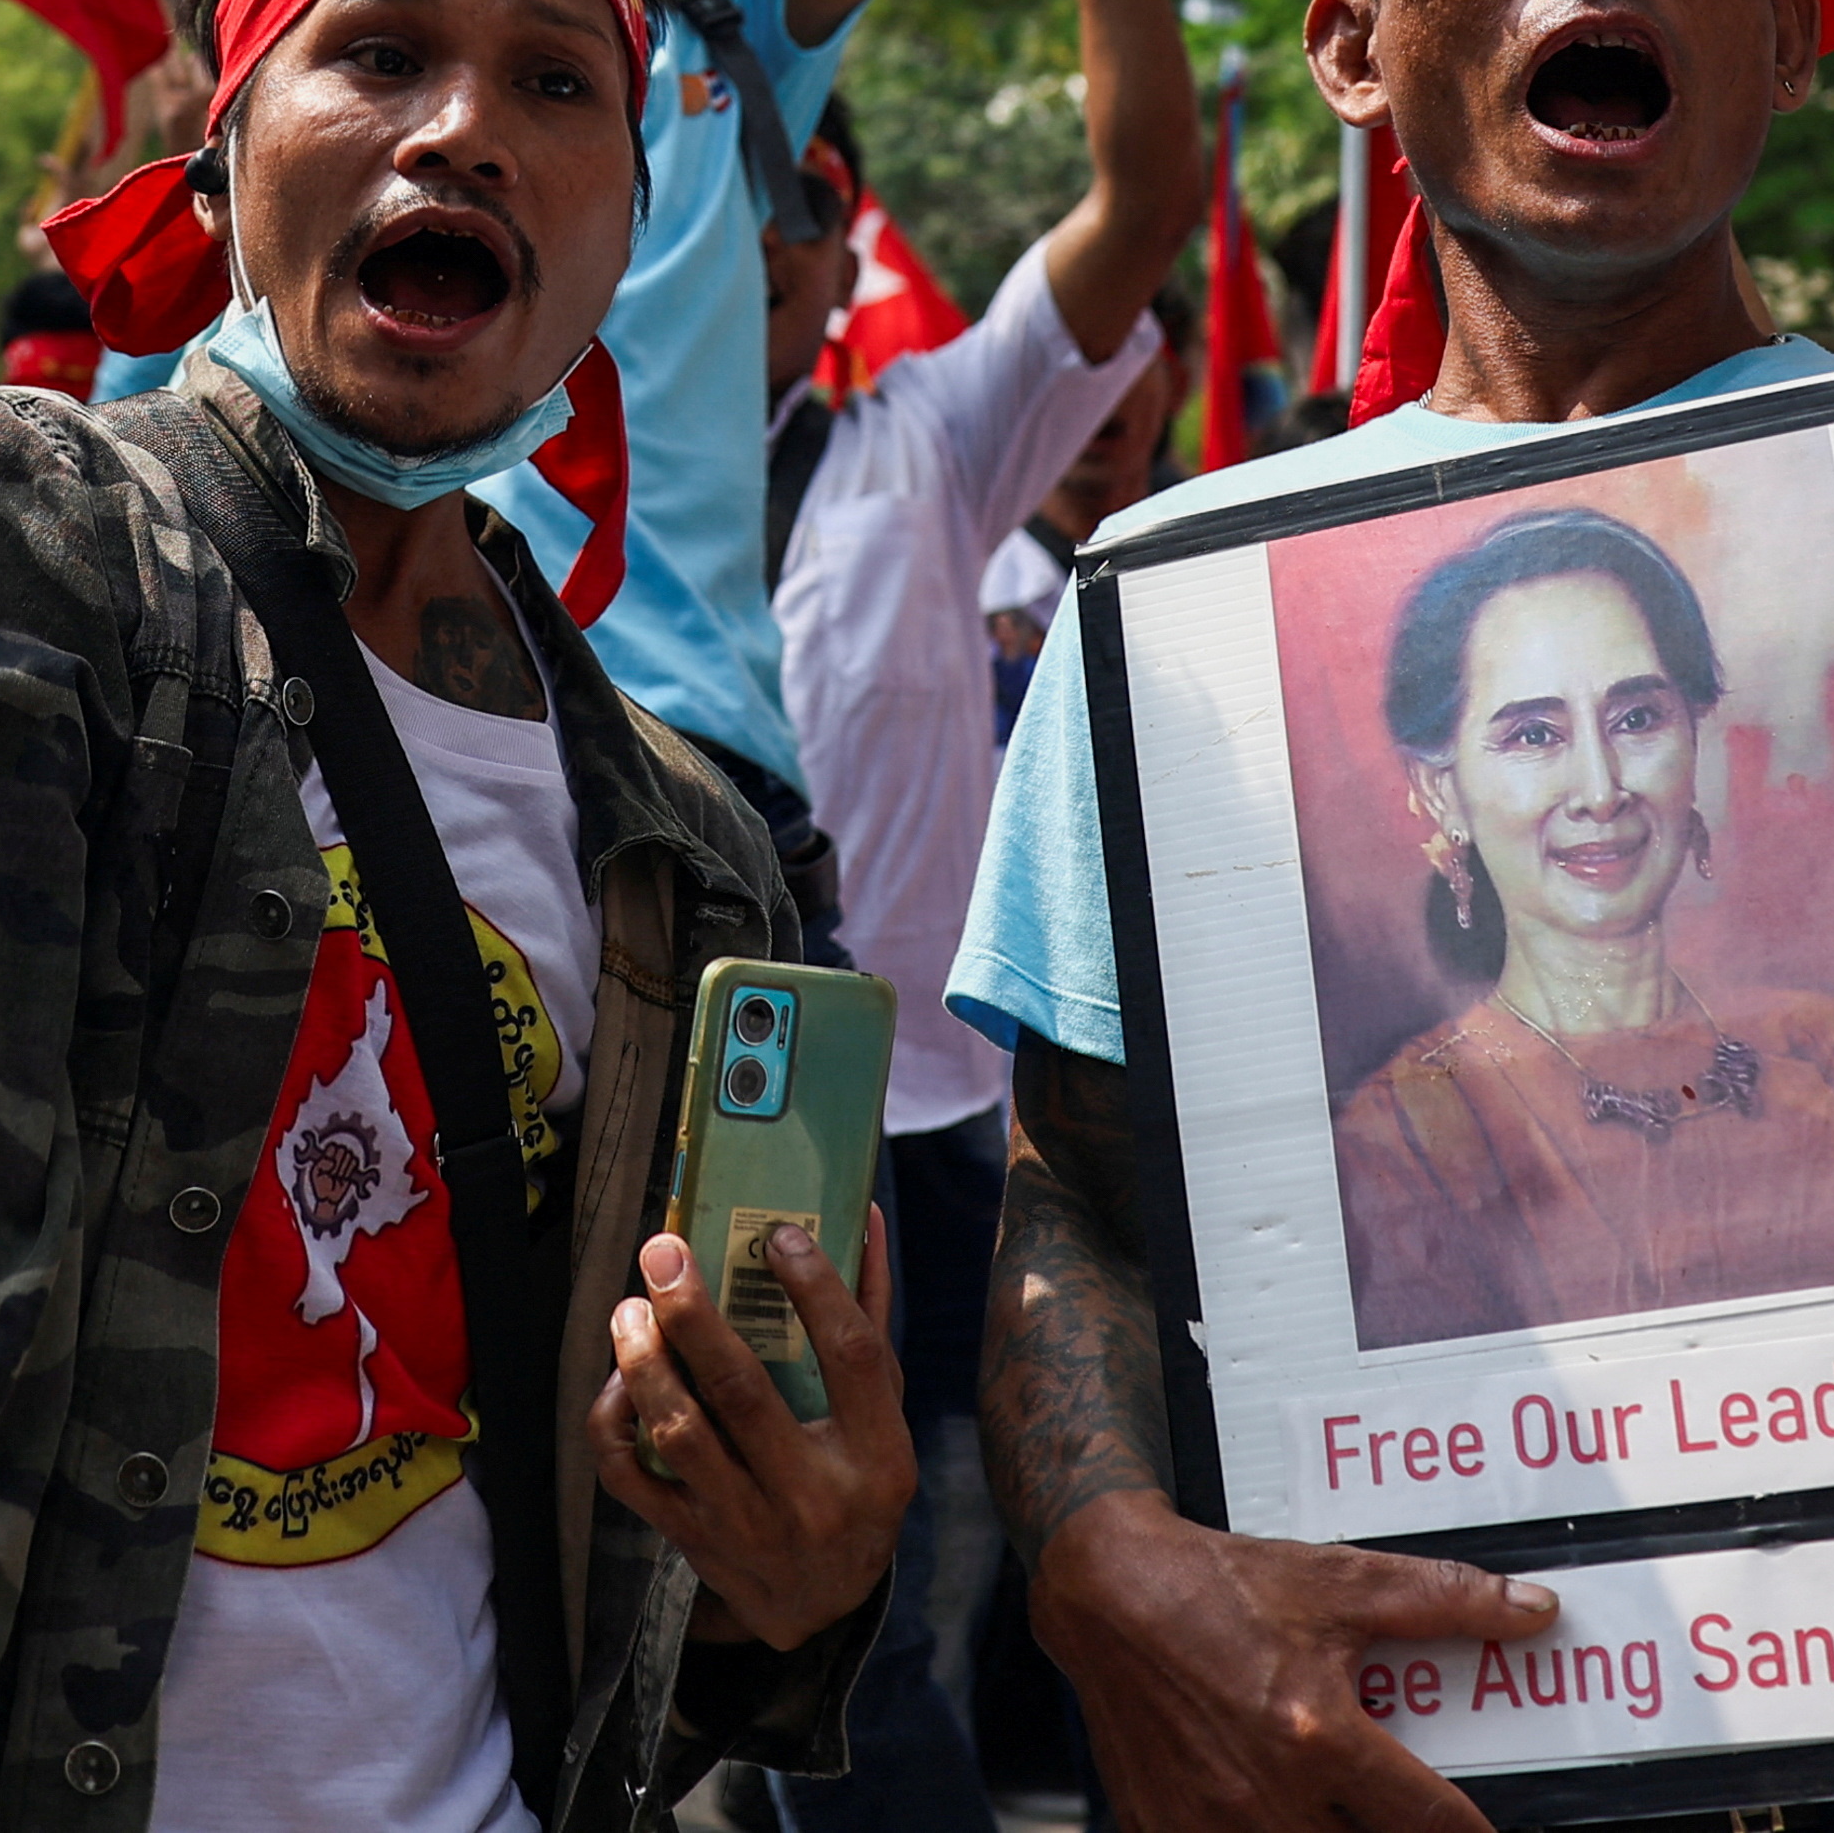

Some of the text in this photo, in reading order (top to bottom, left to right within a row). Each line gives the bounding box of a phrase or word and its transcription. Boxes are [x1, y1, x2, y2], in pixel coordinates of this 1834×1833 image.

[1323, 1414, 1485, 1490] Free
[1511, 1394, 1643, 1470] Our
[1358, 1657, 1443, 1719] ee
[1471, 1638, 1664, 1720] Aung
